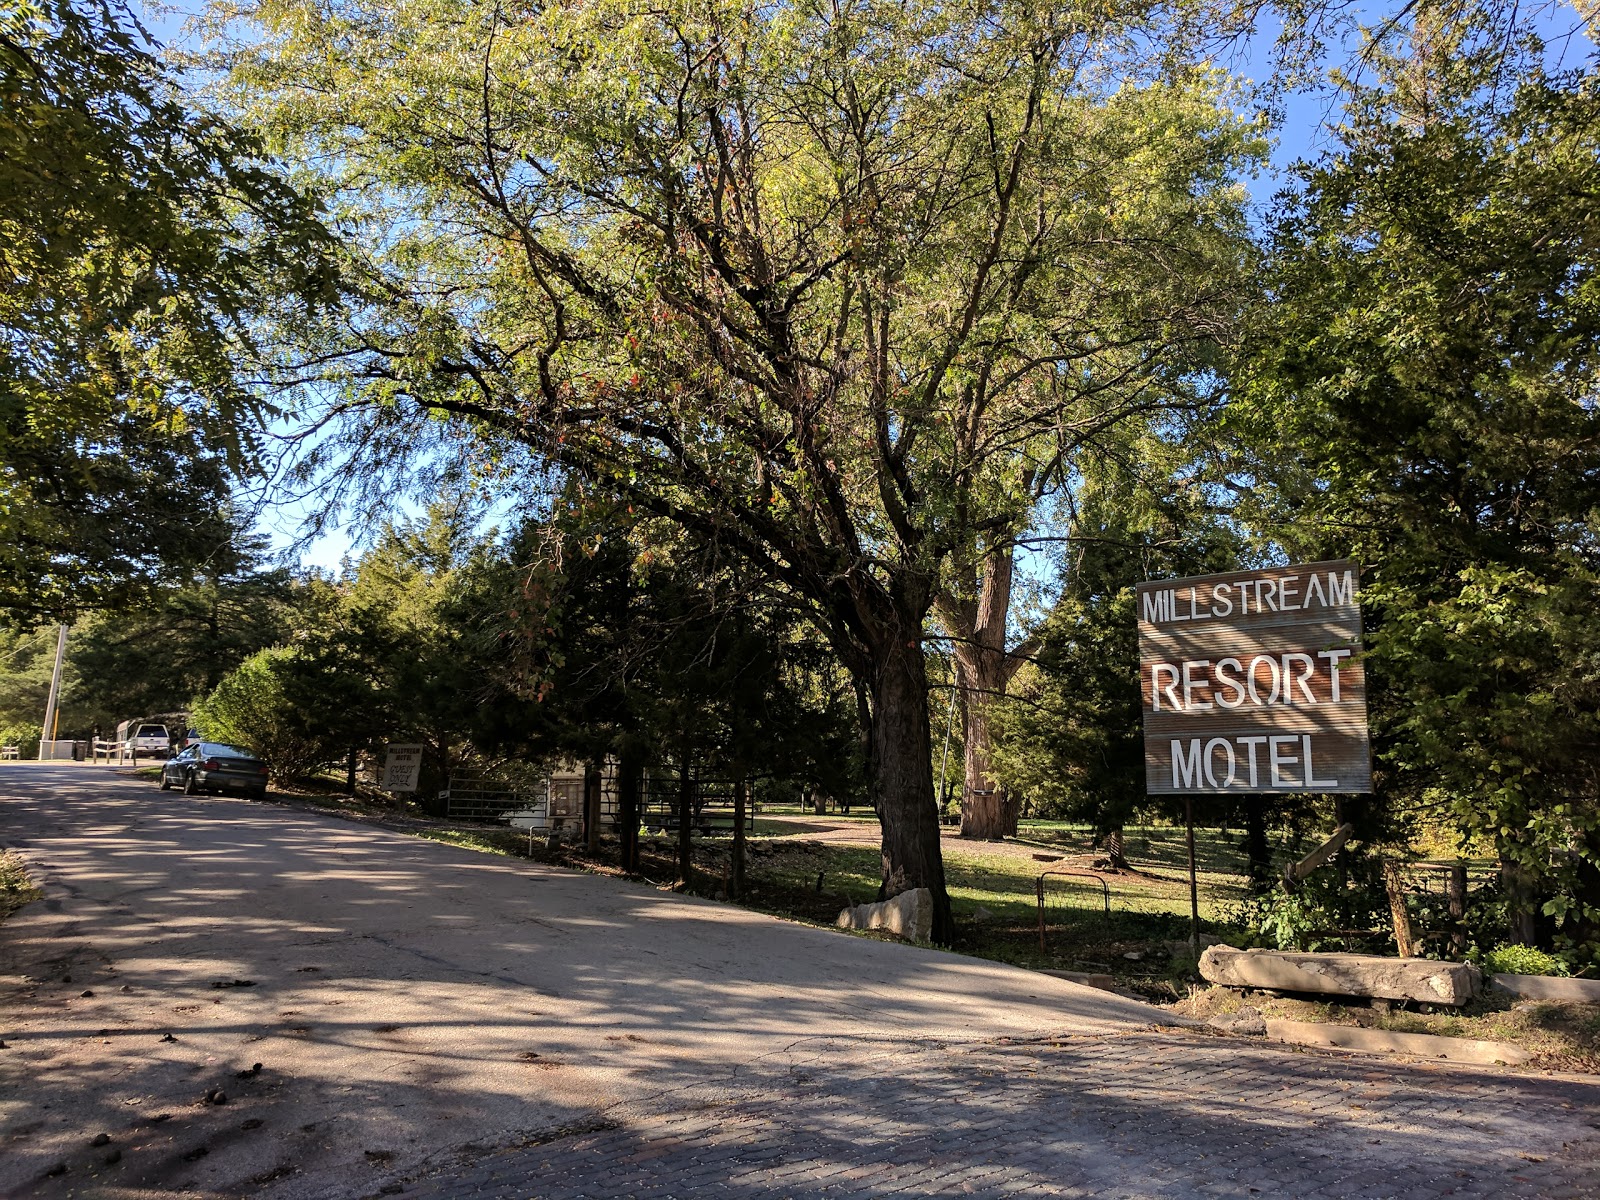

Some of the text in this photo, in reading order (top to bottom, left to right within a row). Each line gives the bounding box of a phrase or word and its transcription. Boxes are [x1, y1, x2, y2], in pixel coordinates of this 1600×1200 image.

[1142, 571, 1353, 623] MILLSTREAM
[1151, 649, 1351, 712] RESORT
[1170, 735, 1338, 789] MOTEL
